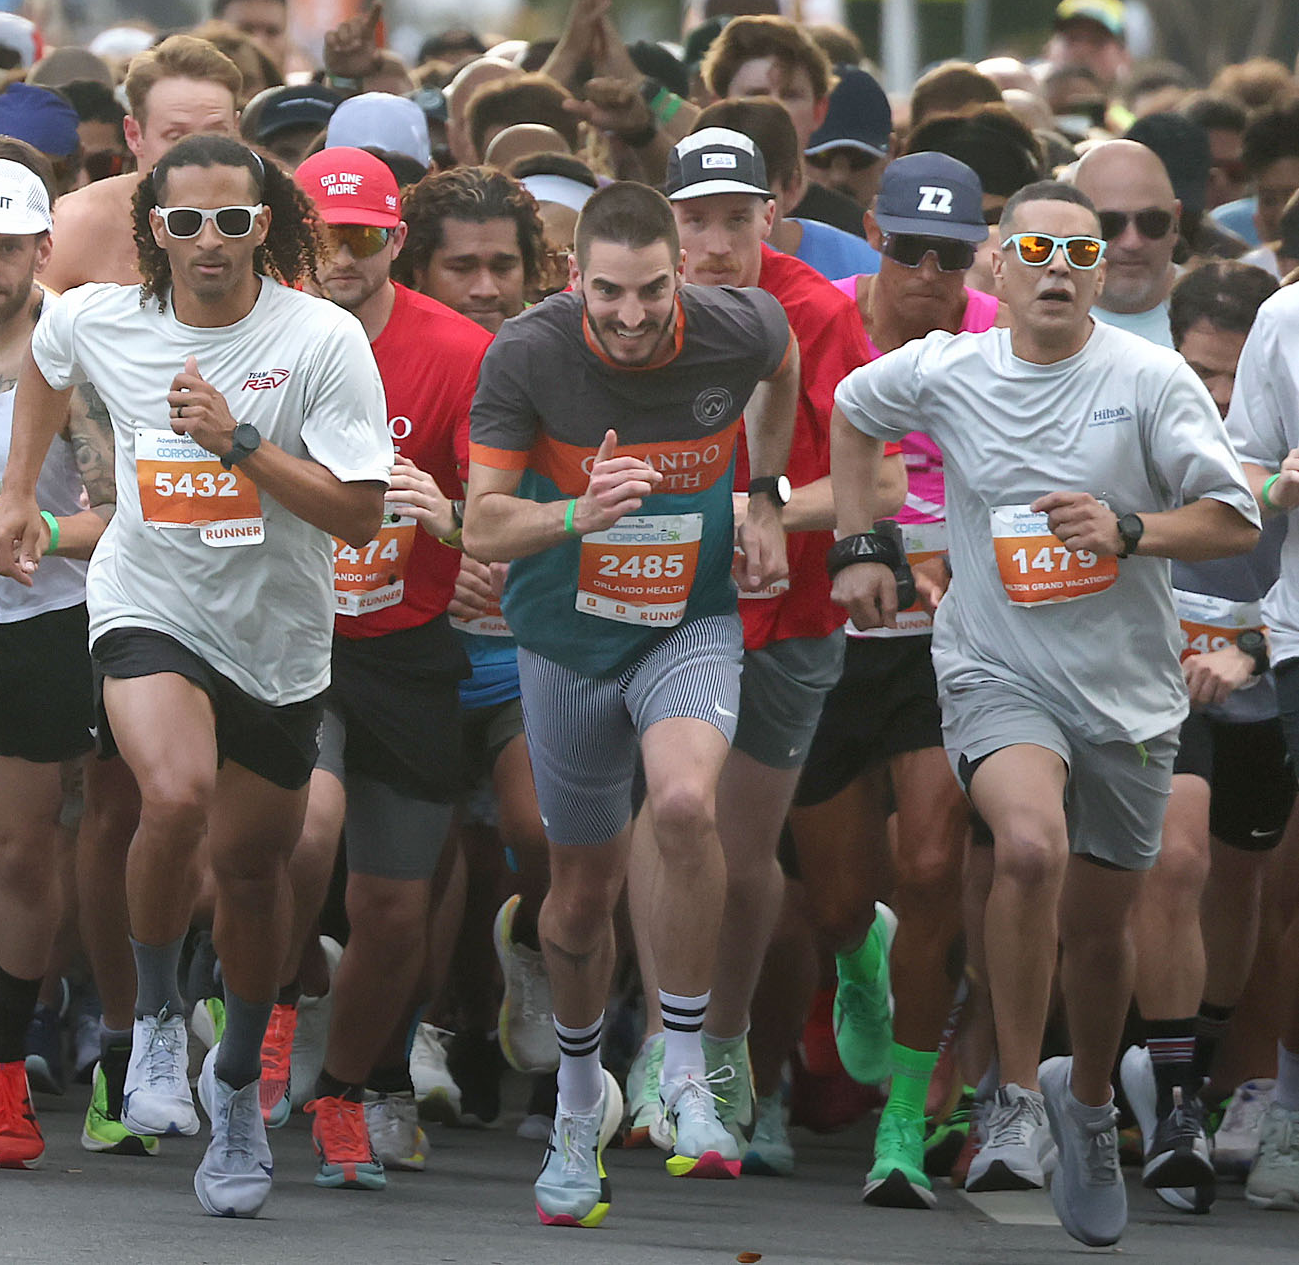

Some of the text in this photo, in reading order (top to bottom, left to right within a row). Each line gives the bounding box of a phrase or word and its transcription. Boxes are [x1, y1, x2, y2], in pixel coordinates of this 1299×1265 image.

[320, 172, 364, 187] GO ONE
[327, 183, 358, 196] MORE
[242, 374, 290, 391] REV
[248, 371, 269, 379] TEAM
[154, 472, 239, 498] 5432
[205, 526, 262, 540] RUNNER
[598, 554, 684, 579] 2485
[1012, 546, 1098, 574] 1479
[593, 579, 685, 595] ORLANDO HEALTH
[1031, 581, 1064, 591] GRAND
[358, 588, 402, 609] RUNNER
